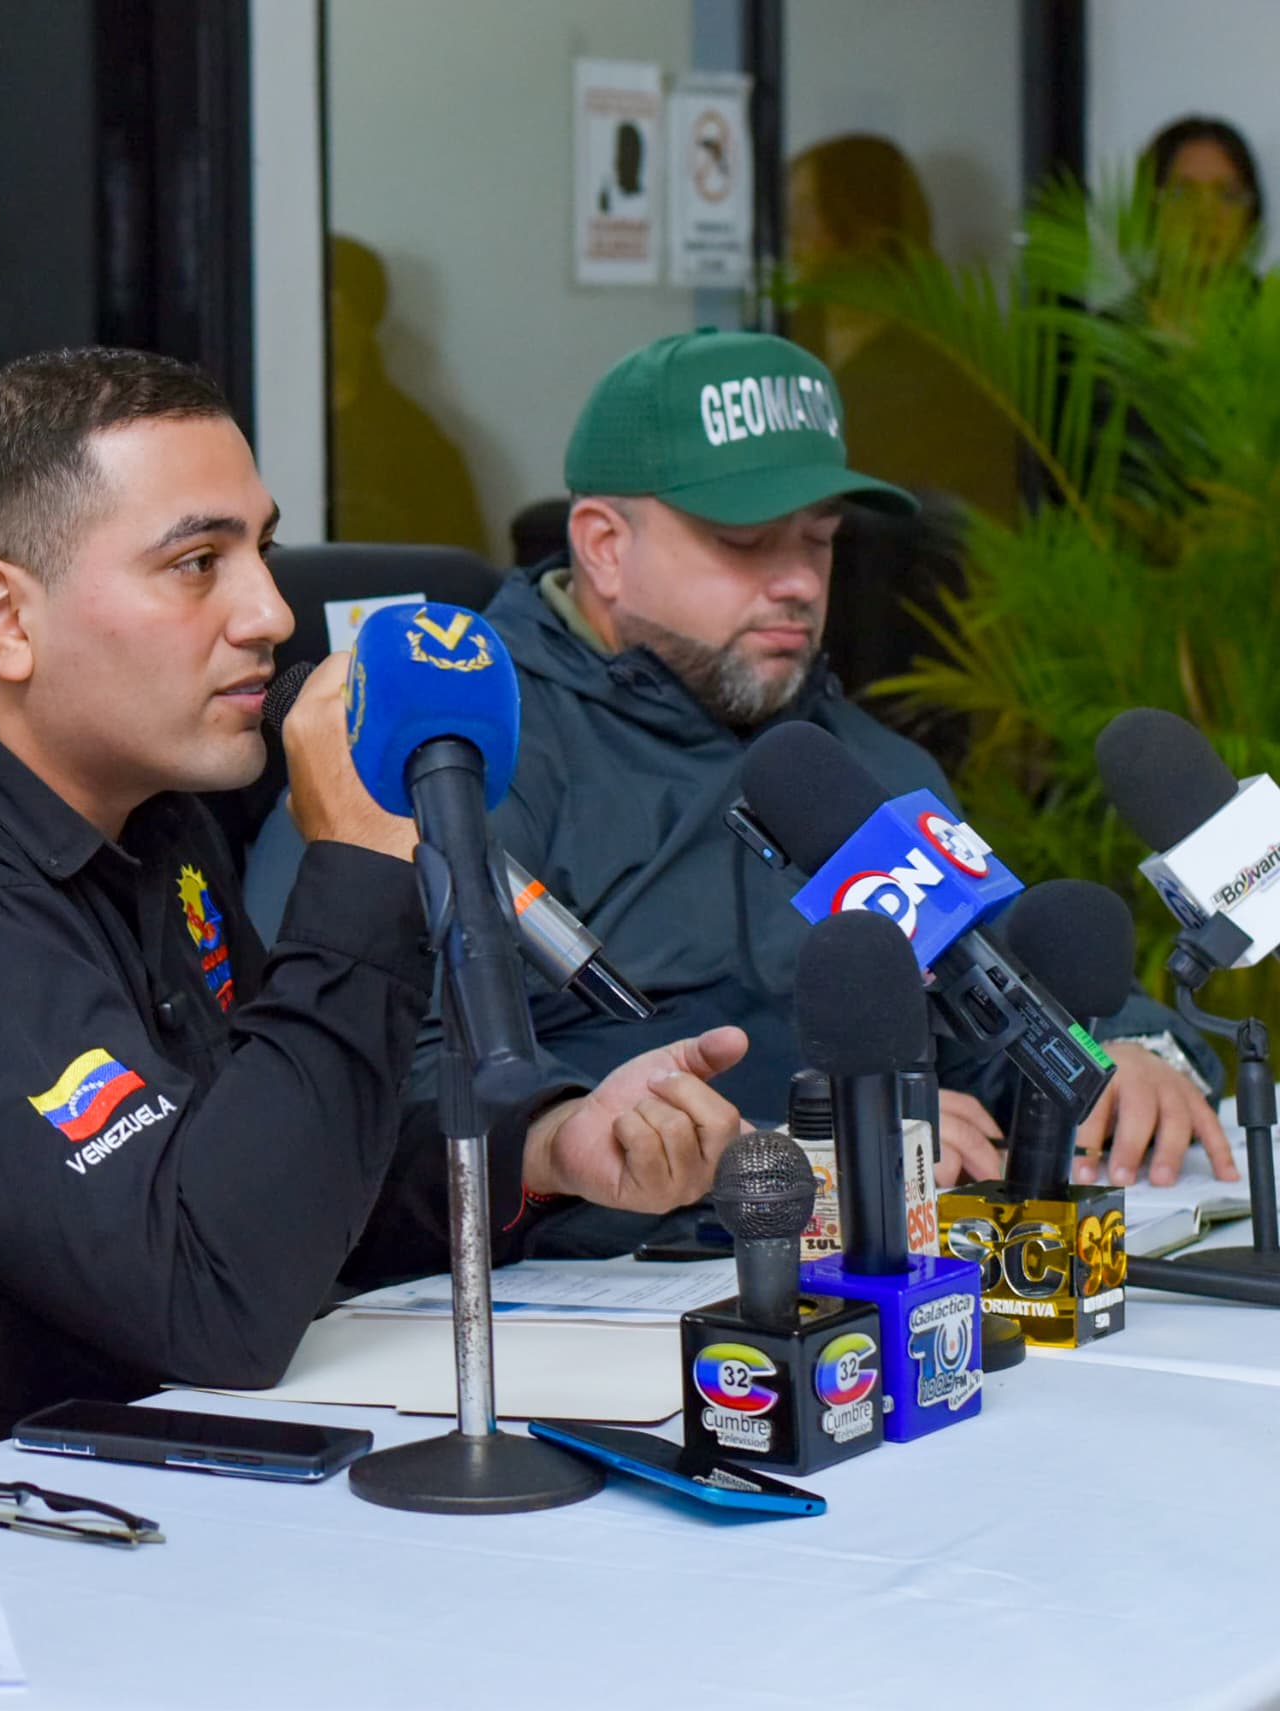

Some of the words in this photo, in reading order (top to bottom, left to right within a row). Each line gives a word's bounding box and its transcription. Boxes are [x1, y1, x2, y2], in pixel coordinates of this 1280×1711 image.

[65, 1094, 178, 1175] VENEZUELA
[979, 1297, 1056, 1317] ORMATIVA
[723, 1365, 749, 1388] 32
[840, 1358, 858, 1381] 32
[703, 1409, 768, 1435] Cumbre
[825, 1402, 871, 1431] Cumbre
